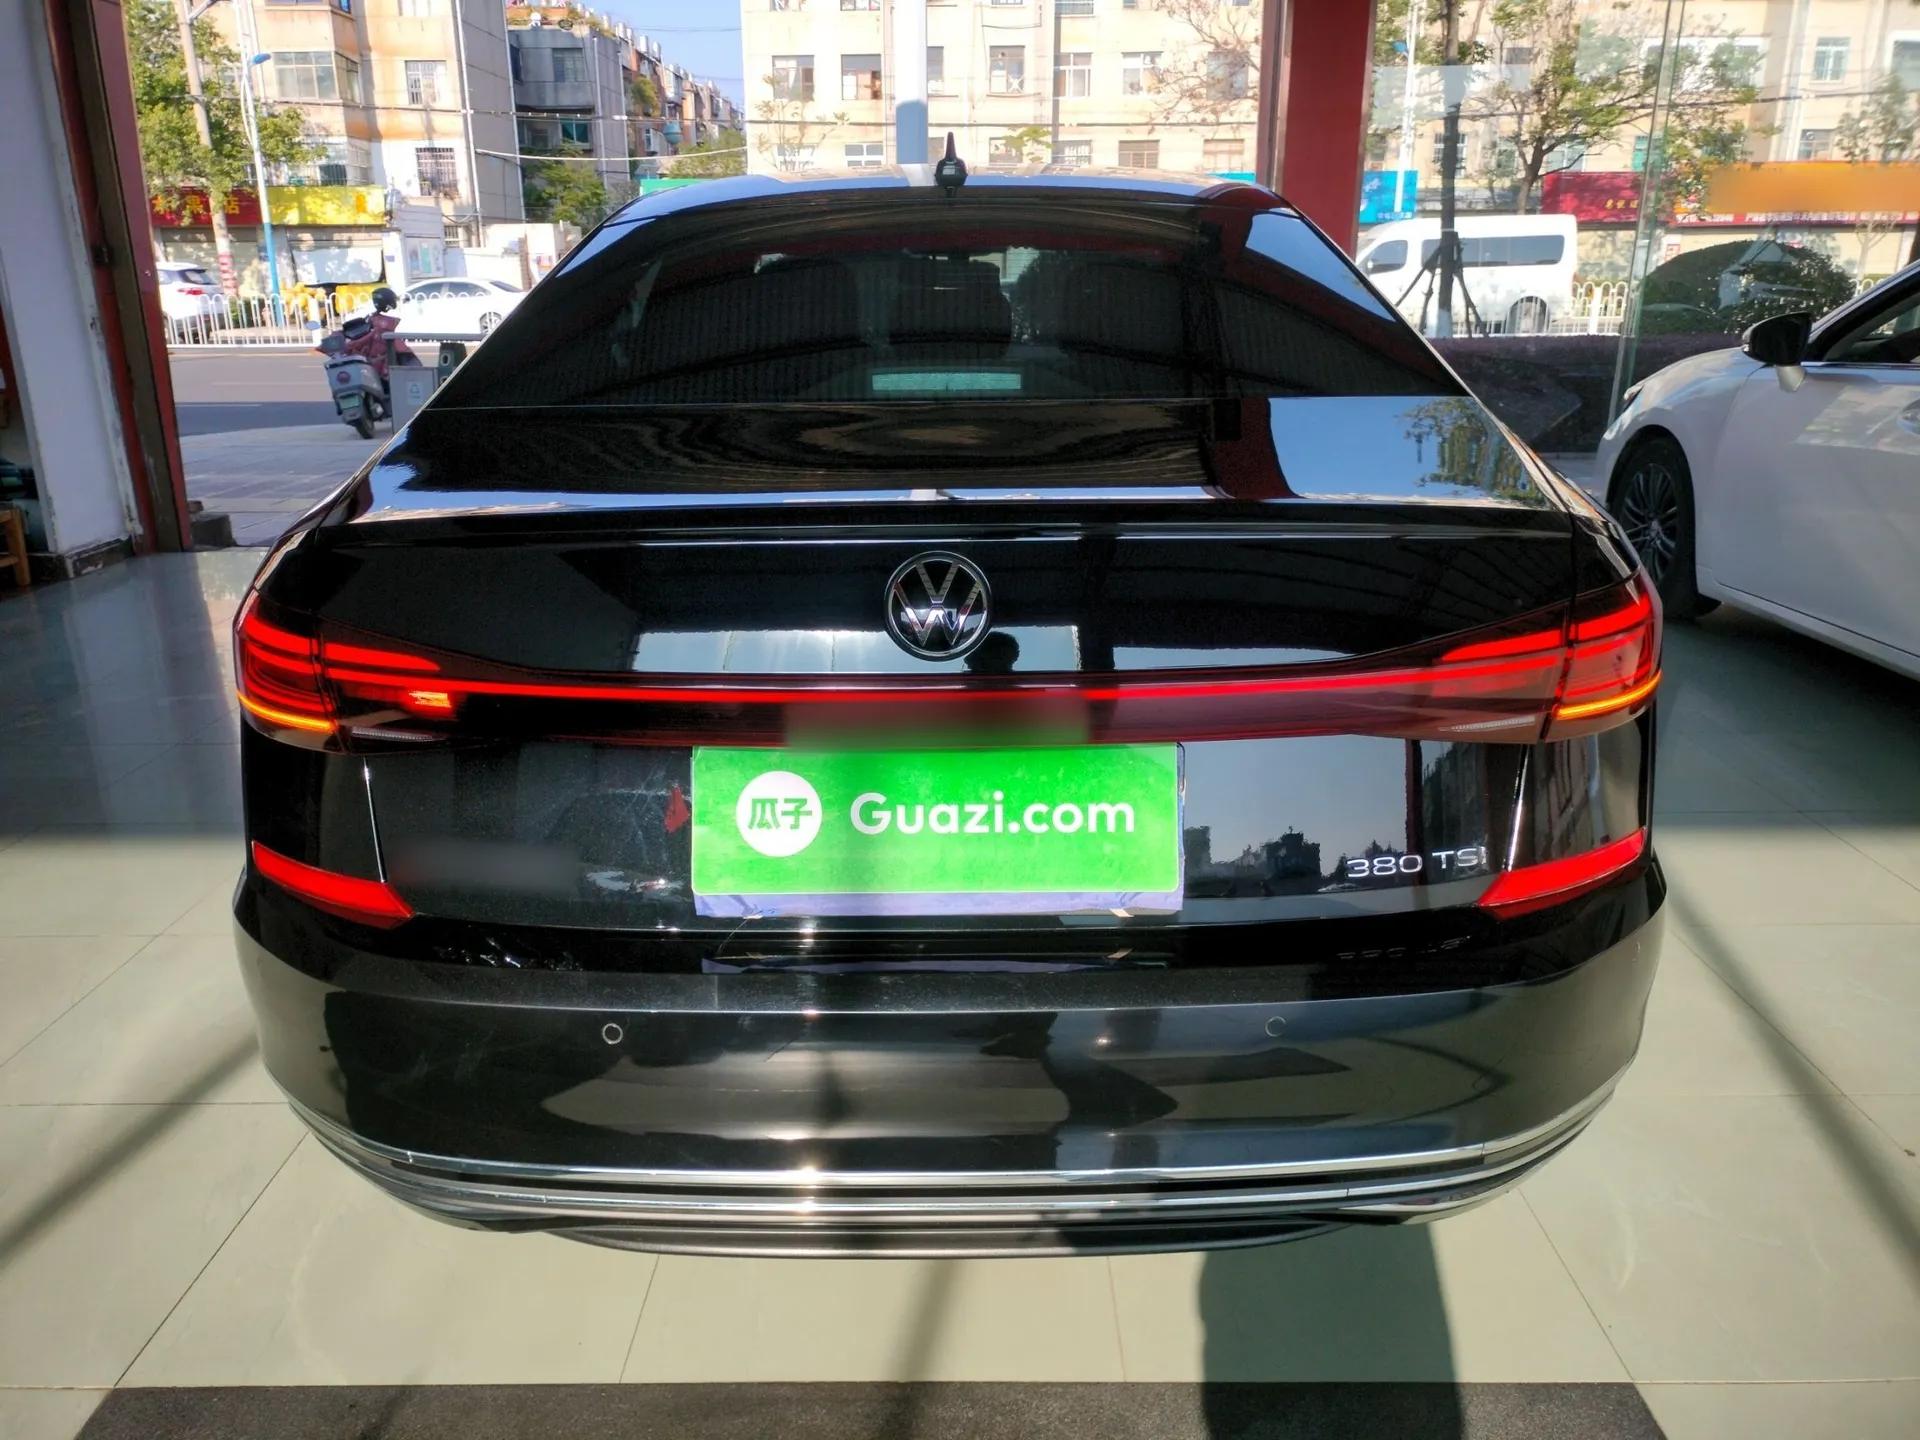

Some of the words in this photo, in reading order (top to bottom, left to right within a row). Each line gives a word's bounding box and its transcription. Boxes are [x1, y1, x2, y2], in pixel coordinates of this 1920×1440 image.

[889, 555, 987, 655] VW
[748, 797, 813, 830] 瓜子
[850, 790, 1135, 835] Guazi.com
[1347, 854, 1423, 878] 380
[1432, 846, 1487, 869] TSI
